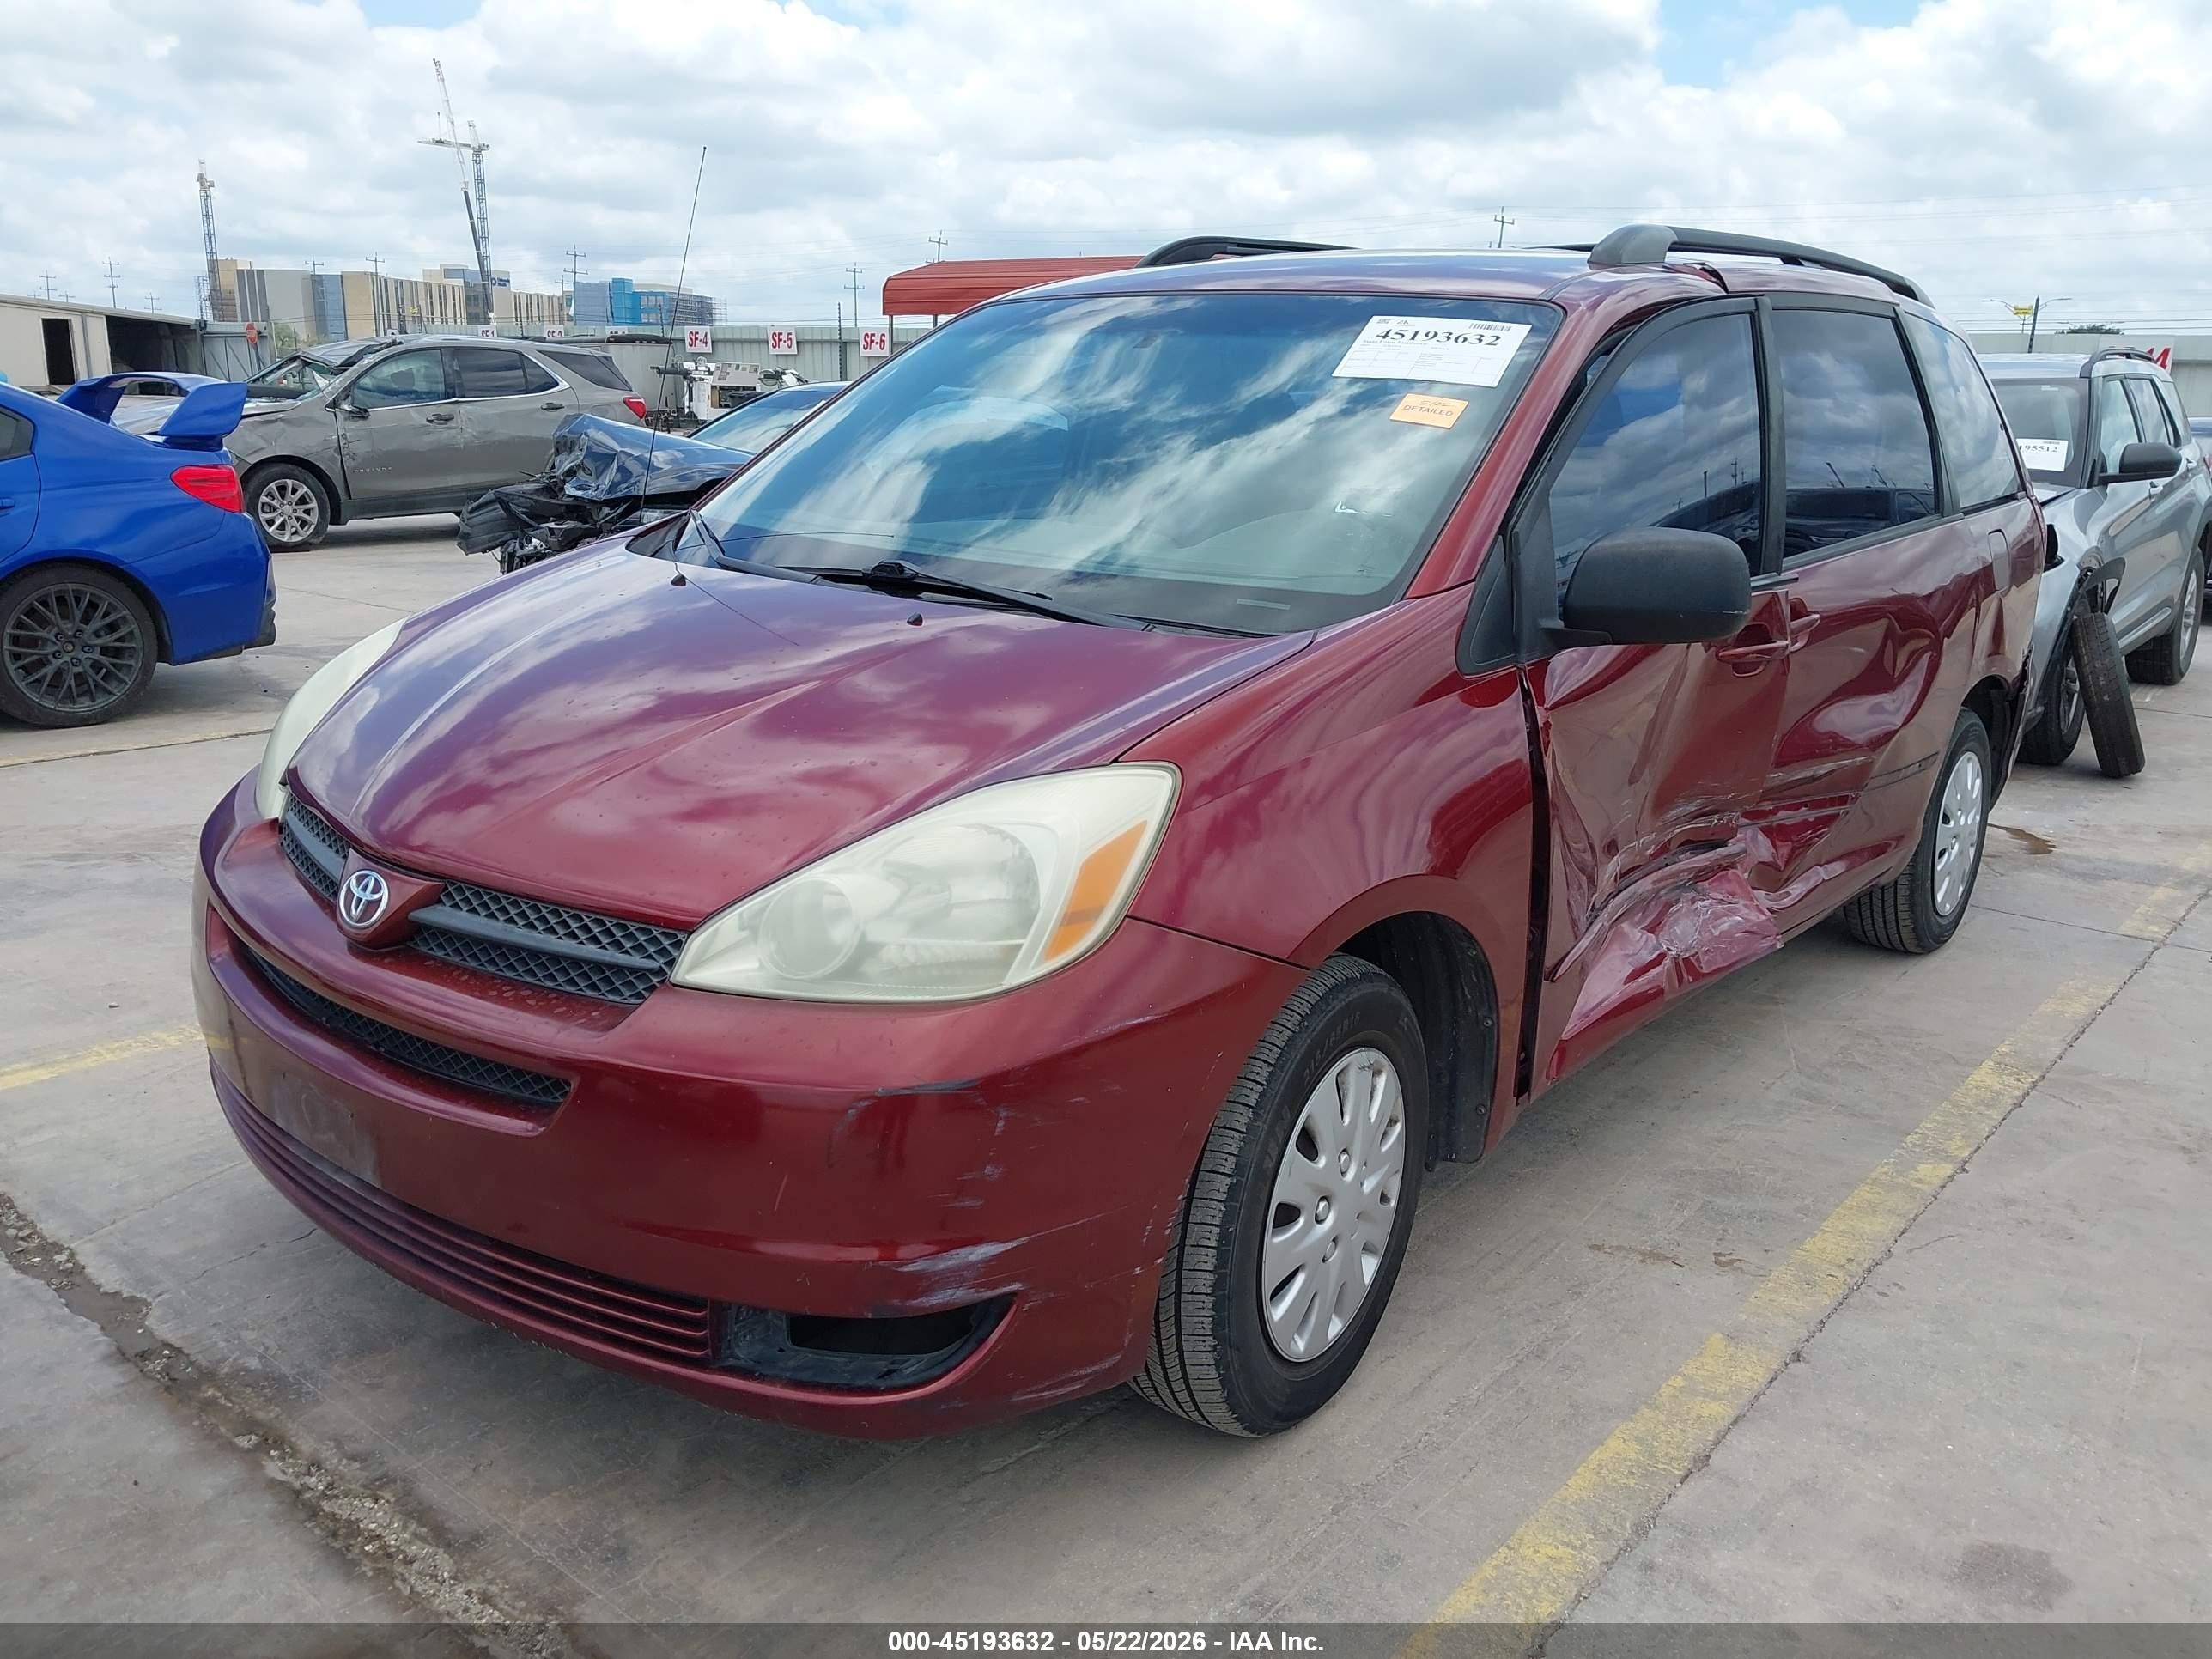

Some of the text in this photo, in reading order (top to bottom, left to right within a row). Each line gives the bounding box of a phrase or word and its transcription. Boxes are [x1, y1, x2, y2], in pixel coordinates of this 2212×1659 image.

[688, 331, 708, 348] SF-4
[771, 331, 793, 349] SF-5
[862, 332, 886, 351] SF-6
[1376, 329, 1501, 346] 45193632
[1401, 404, 1454, 416] DETAILED
